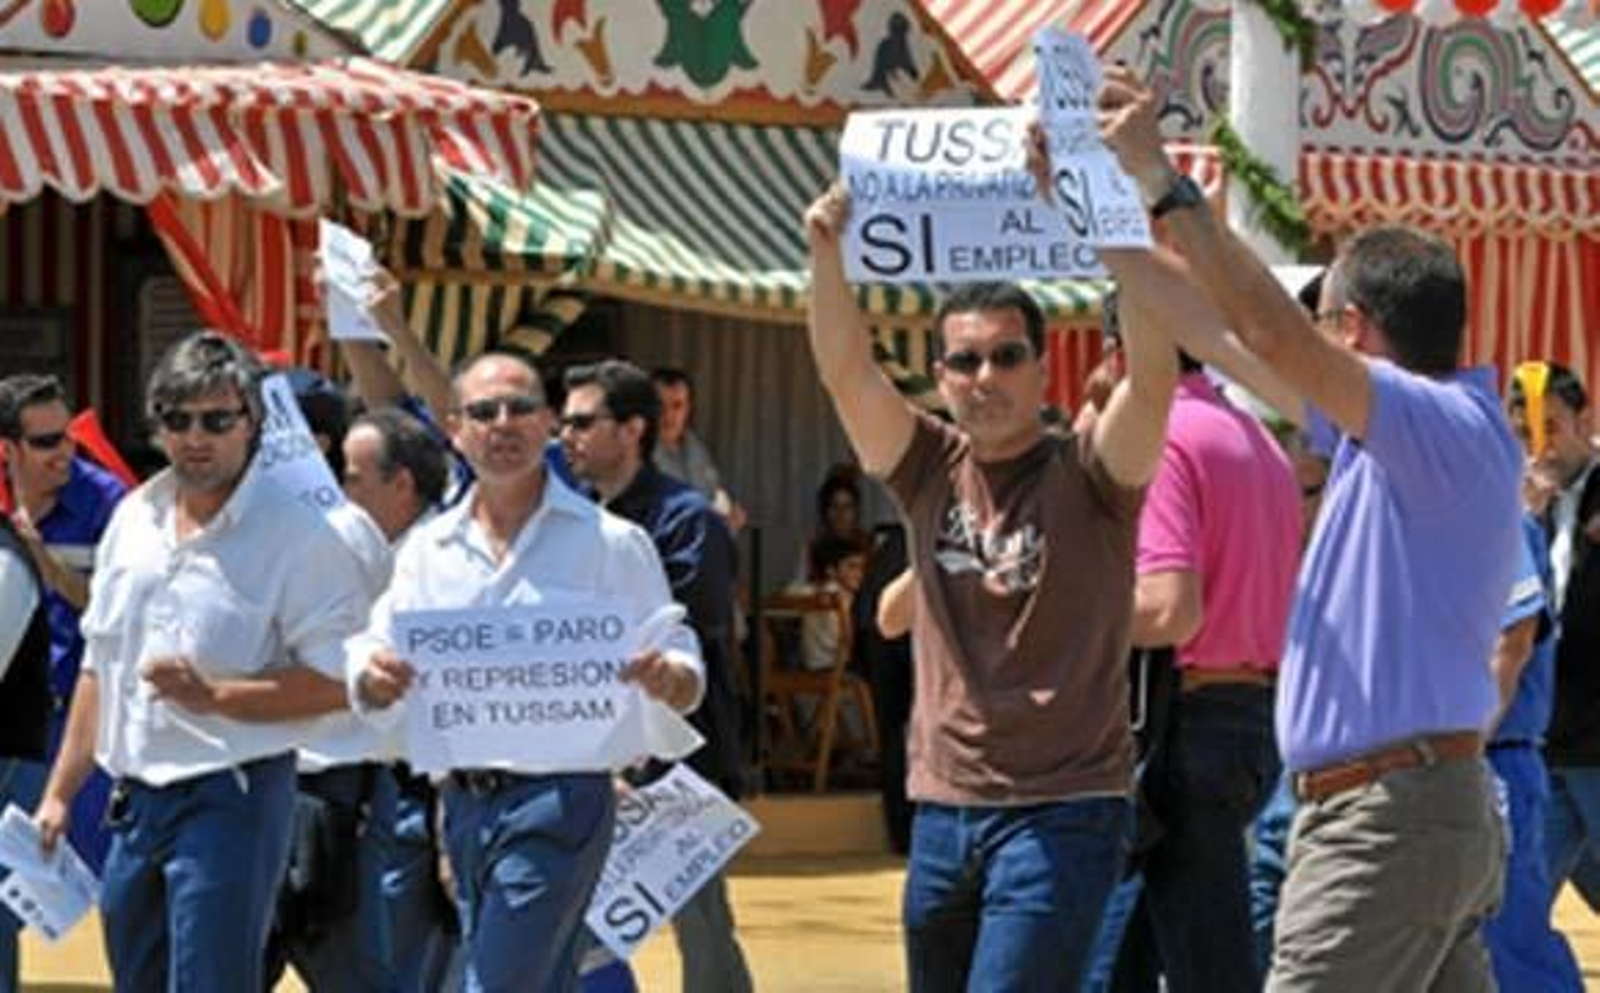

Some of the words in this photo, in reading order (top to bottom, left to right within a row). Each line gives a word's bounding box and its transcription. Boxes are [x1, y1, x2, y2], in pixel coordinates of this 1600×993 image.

[875, 117, 1016, 165] TUSS
[1001, 209, 1046, 235] AL
[860, 213, 936, 276] SI
[951, 244, 1099, 273] EMPLEO
[407, 623, 496, 654] PSOE
[533, 614, 625, 645] PARO
[431, 702, 476, 729] EN
[488, 697, 616, 726] TUSSAM
[604, 880, 666, 944] SI
